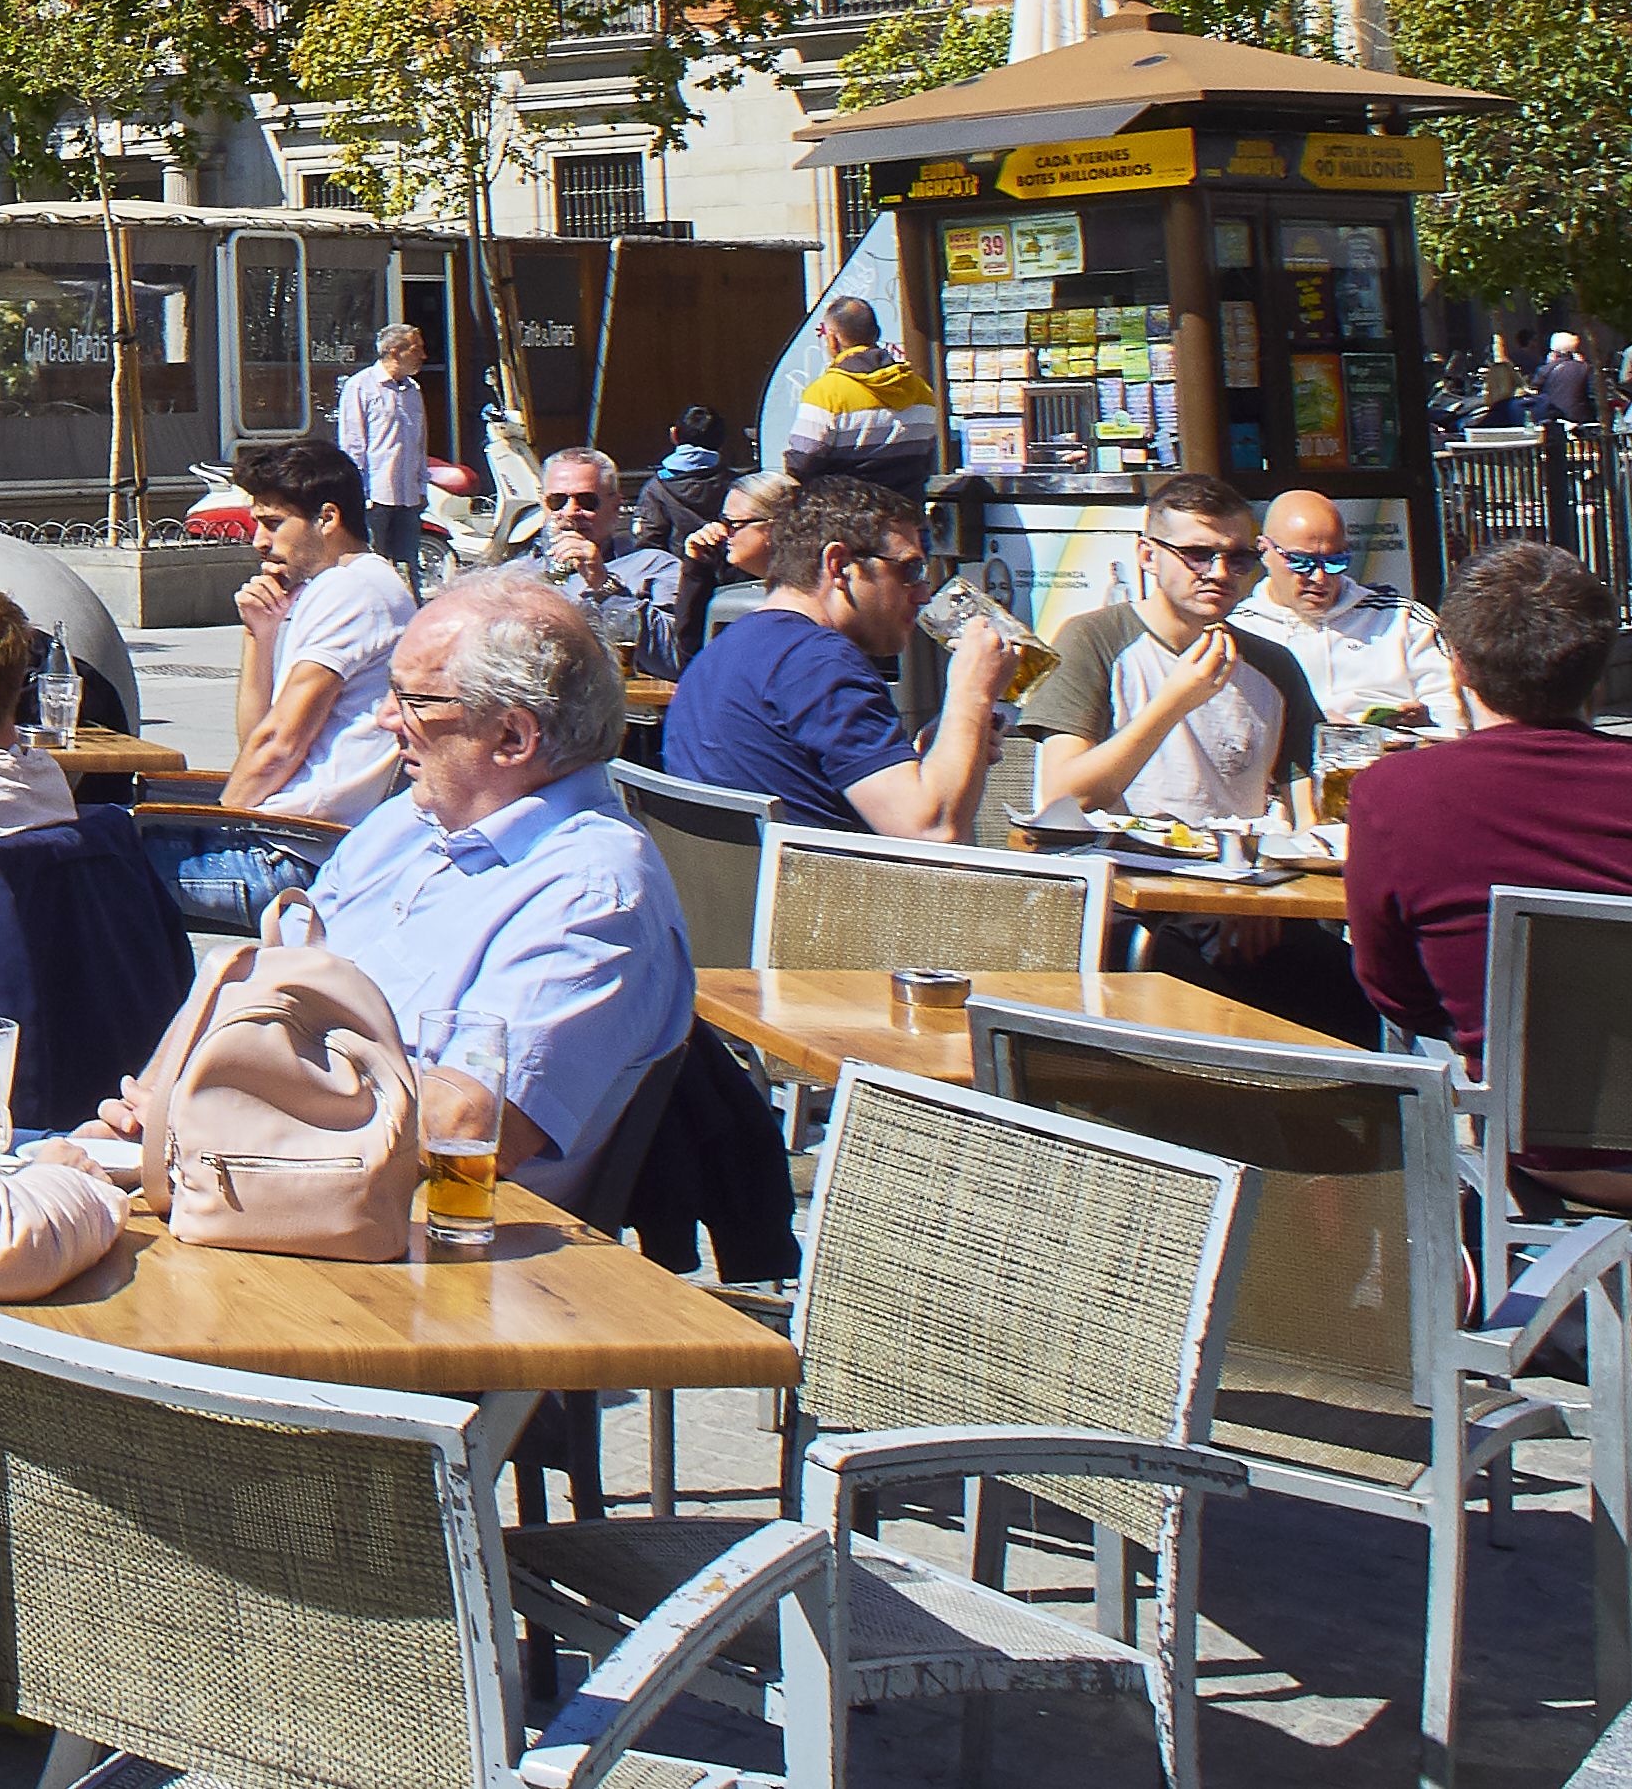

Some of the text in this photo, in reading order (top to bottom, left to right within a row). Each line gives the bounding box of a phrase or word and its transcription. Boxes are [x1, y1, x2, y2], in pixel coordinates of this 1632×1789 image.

[1035, 148, 1130, 169] CADA VIERNES
[1016, 172, 1056, 187] BOTES
[1059, 164, 1152, 183] MILLONARIOS
[1339, 161, 1415, 179] MILLONES
[981, 234, 1004, 257] 39
